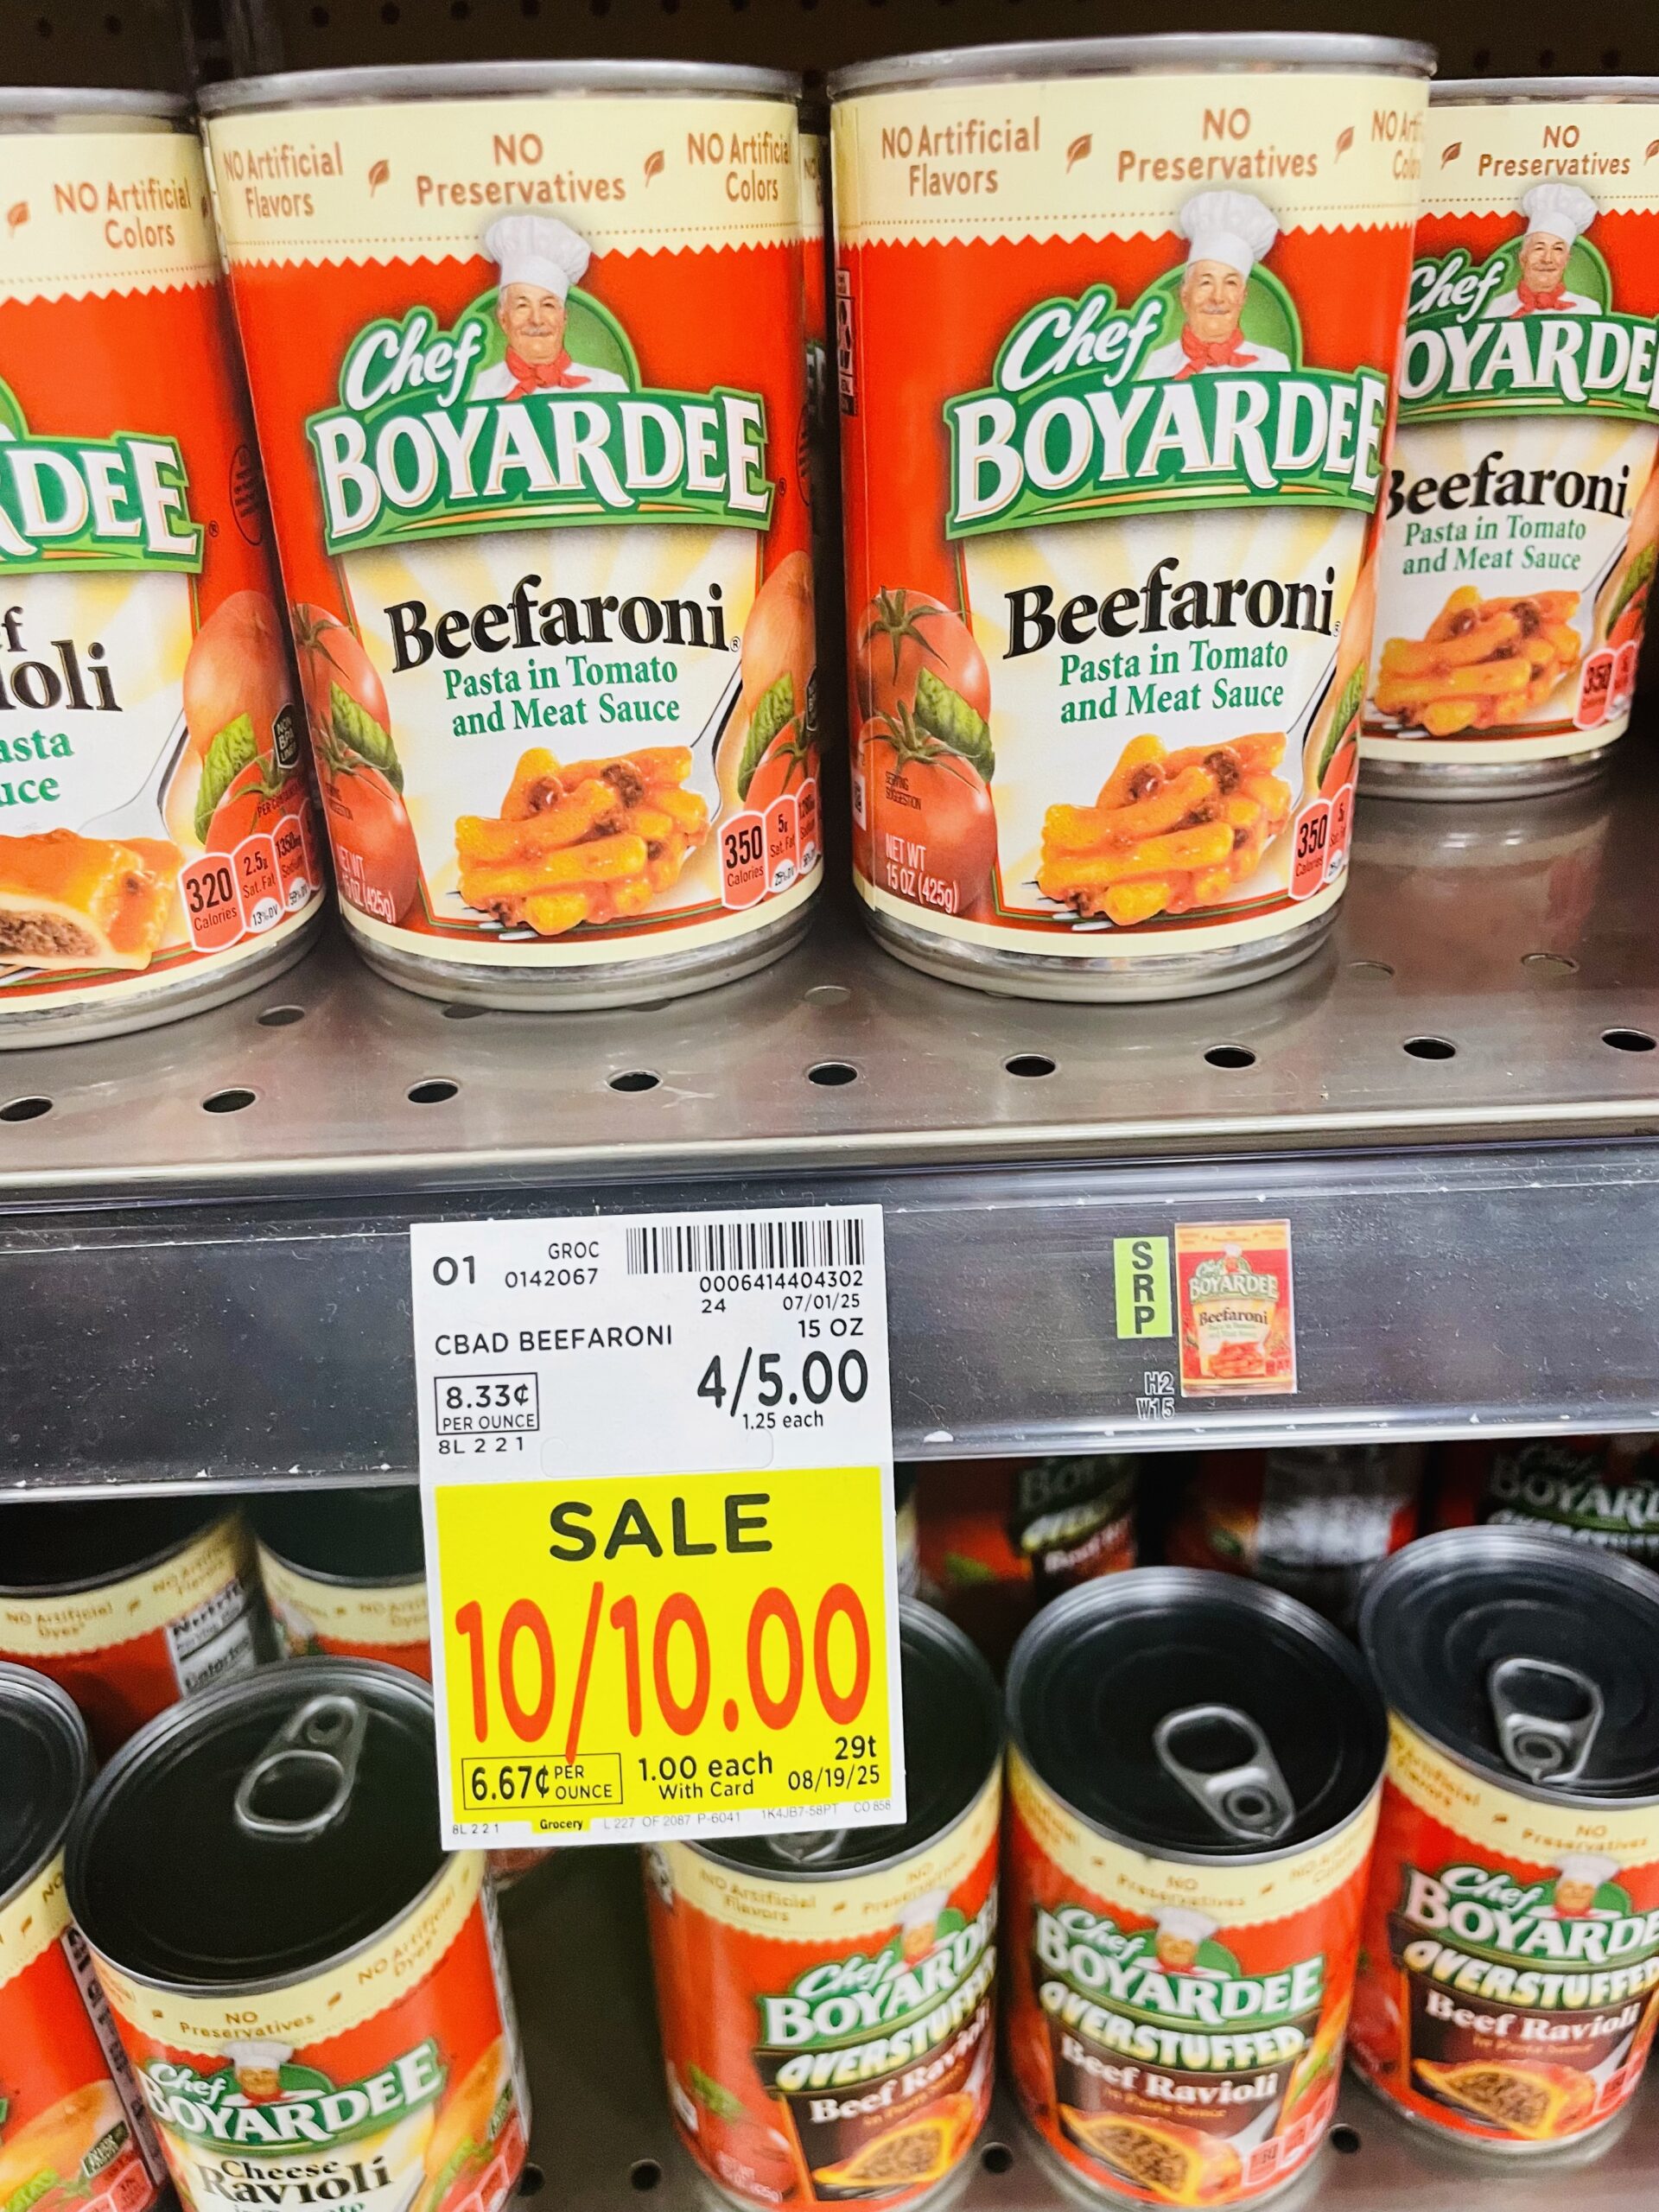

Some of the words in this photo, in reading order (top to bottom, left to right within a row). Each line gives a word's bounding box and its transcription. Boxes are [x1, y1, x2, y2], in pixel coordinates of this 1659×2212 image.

[881, 127, 912, 159] NO
[918, 116, 1040, 157] Artificial
[1203, 108, 1250, 141] NO
[1371, 111, 1397, 142] NO
[1543, 124, 1580, 149] NO
[223, 149, 245, 182] NO
[248, 141, 344, 181] Artificial
[493, 133, 544, 166] NO
[688, 132, 724, 165] NO
[1117, 145, 1319, 182] Preservatives
[1478, 152, 1631, 177] Preservatives
[54, 183, 99, 213] NO
[106, 178, 192, 213] Artificial
[416, 170, 626, 207] Preservatives
[726, 170, 779, 203] Colors
[909, 163, 999, 197] Flavors
[245, 187, 315, 219] Flavors
[105, 219, 176, 250] Colors
[1408, 257, 1505, 323] Chef
[1001, 295, 1162, 393] Chef
[345, 316, 483, 412] Chef
[1398, 320, 1659, 410] OYARDE
[314, 396, 771, 539] BOYARDEE
[954, 377, 1386, 524] BOYARDEE
[1404, 520, 1467, 547] Pasta
[1475, 517, 1499, 540] in
[1506, 515, 1586, 540] Tomato
[1403, 548, 1448, 575] and
[1453, 547, 1514, 572] Meat
[1522, 545, 1581, 571] Sauce
[384, 574, 729, 674] Beefaroni
[1002, 556, 1335, 660] Beefaroni
[443, 665, 520, 701] Pasta
[529, 658, 560, 690] in
[566, 654, 678, 688] Tomato
[1059, 652, 1141, 686] Pasta
[1148, 644, 1180, 676] in
[1189, 639, 1288, 672] Tomato
[452, 700, 505, 737] and
[513, 698, 587, 730] Meat
[599, 692, 680, 723] Sauce
[1061, 687, 1117, 724] and
[1126, 683, 1201, 716] Meat
[1211, 677, 1284, 709] Sauce
[725, 824, 763, 869] 350
[886, 833, 906, 865] NET
[906, 842, 927, 871] WT
[1298, 814, 1328, 858] 350
[186, 867, 233, 913] 320
[727, 866, 765, 887] Calories
[887, 863, 899, 891] 15
[900, 869, 916, 898] OZ
[918, 873, 961, 915] (425g)
[194, 907, 238, 931] Calories
[363, 880, 397, 925] (425g)
[548, 1241, 600, 1260] GROC
[505, 1268, 599, 1288] 0142067
[700, 1269, 863, 1293] 0006414404302
[702, 1298, 727, 1313] 24
[783, 1292, 861, 1313] 07/01/25
[1198, 1306, 1268, 1326] Beefaroni
[435, 1332, 509, 1356] CBAD
[519, 1325, 672, 1352] BEEFARONI
[798, 1319, 821, 1338] 15
[830, 1318, 864, 1337] OZ
[446, 1383, 530, 1409] 8.33¢
[697, 1346, 868, 1418] 4/5.00
[442, 1415, 474, 1432] PER
[479, 1414, 536, 1430] OUNCE
[742, 1412, 776, 1430] 1.25
[783, 1409, 824, 1428] each
[439, 1440, 466, 1455] 8L
[474, 1438, 486, 1453] 2
[495, 1437, 507, 1452] 2
[516, 1436, 524, 1451] 1
[550, 1492, 773, 1561] SALE
[454, 1580, 872, 1766] 10/10.00
[835, 1734, 878, 1761] 29t
[472, 1764, 550, 1801] 6.67¢
[555, 1764, 585, 1780] PER
[638, 1755, 697, 1783] 1.00
[708, 1750, 773, 1778] each
[788, 1764, 880, 1794] 08/19/25
[555, 1783, 613, 1800] OUNCE
[658, 1782, 703, 1801] With
[710, 1778, 754, 1798] Card
[539, 1817, 584, 1832] Grocery
[614, 1816, 636, 1829] 227
[642, 1815, 661, 1828] OF
[664, 1813, 691, 1827] 2087
[697, 1811, 741, 1825] P-6041
[1576, 1824, 1609, 1837] NO
[1440, 1866, 1545, 1913] Chef
[1057, 1907, 1147, 1960] Chef
[795, 1949, 894, 2000] Chef
[1037, 1909, 1325, 2025] BOYARDEE
[180, 2014, 315, 2040] Preservatives
[226, 2011, 258, 2025] NO
[1039, 1980, 1306, 2070] OVERSTUFFED
[1426, 1988, 1517, 2038] Beef
[1521, 2001, 1642, 2043] Ravioli
[147, 2062, 227, 2105] Chef
[1061, 2033, 1141, 2090] Beef
[1146, 2072, 1279, 2106] Ravioli
[137, 2043, 442, 2142] BOYARDEE
[810, 2079, 899, 2125] Beef
[193, 2155, 394, 2205] Ravioli
[220, 2159, 340, 2181] Cheese
